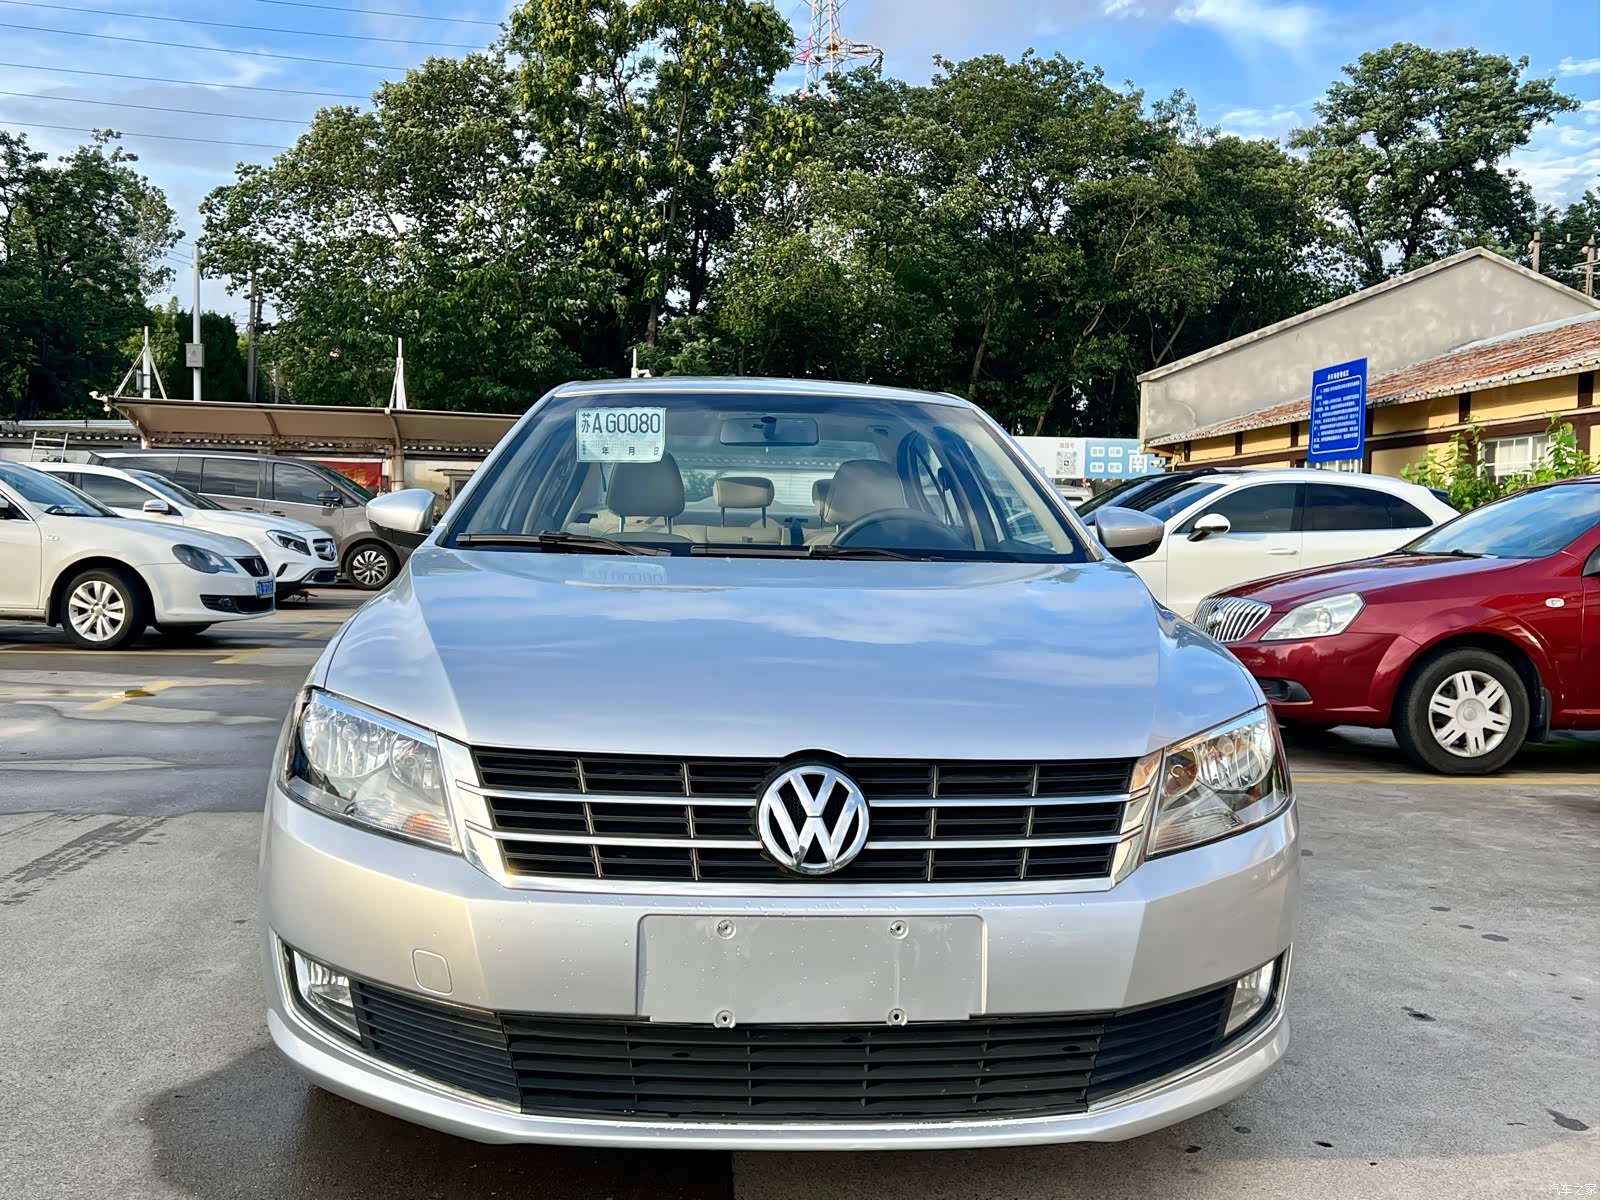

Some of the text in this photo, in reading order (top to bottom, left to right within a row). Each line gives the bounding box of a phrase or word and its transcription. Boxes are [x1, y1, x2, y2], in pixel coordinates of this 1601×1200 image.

[602, 446, 660, 456] 年 月 日
[1127, 447, 1148, 474] 南
